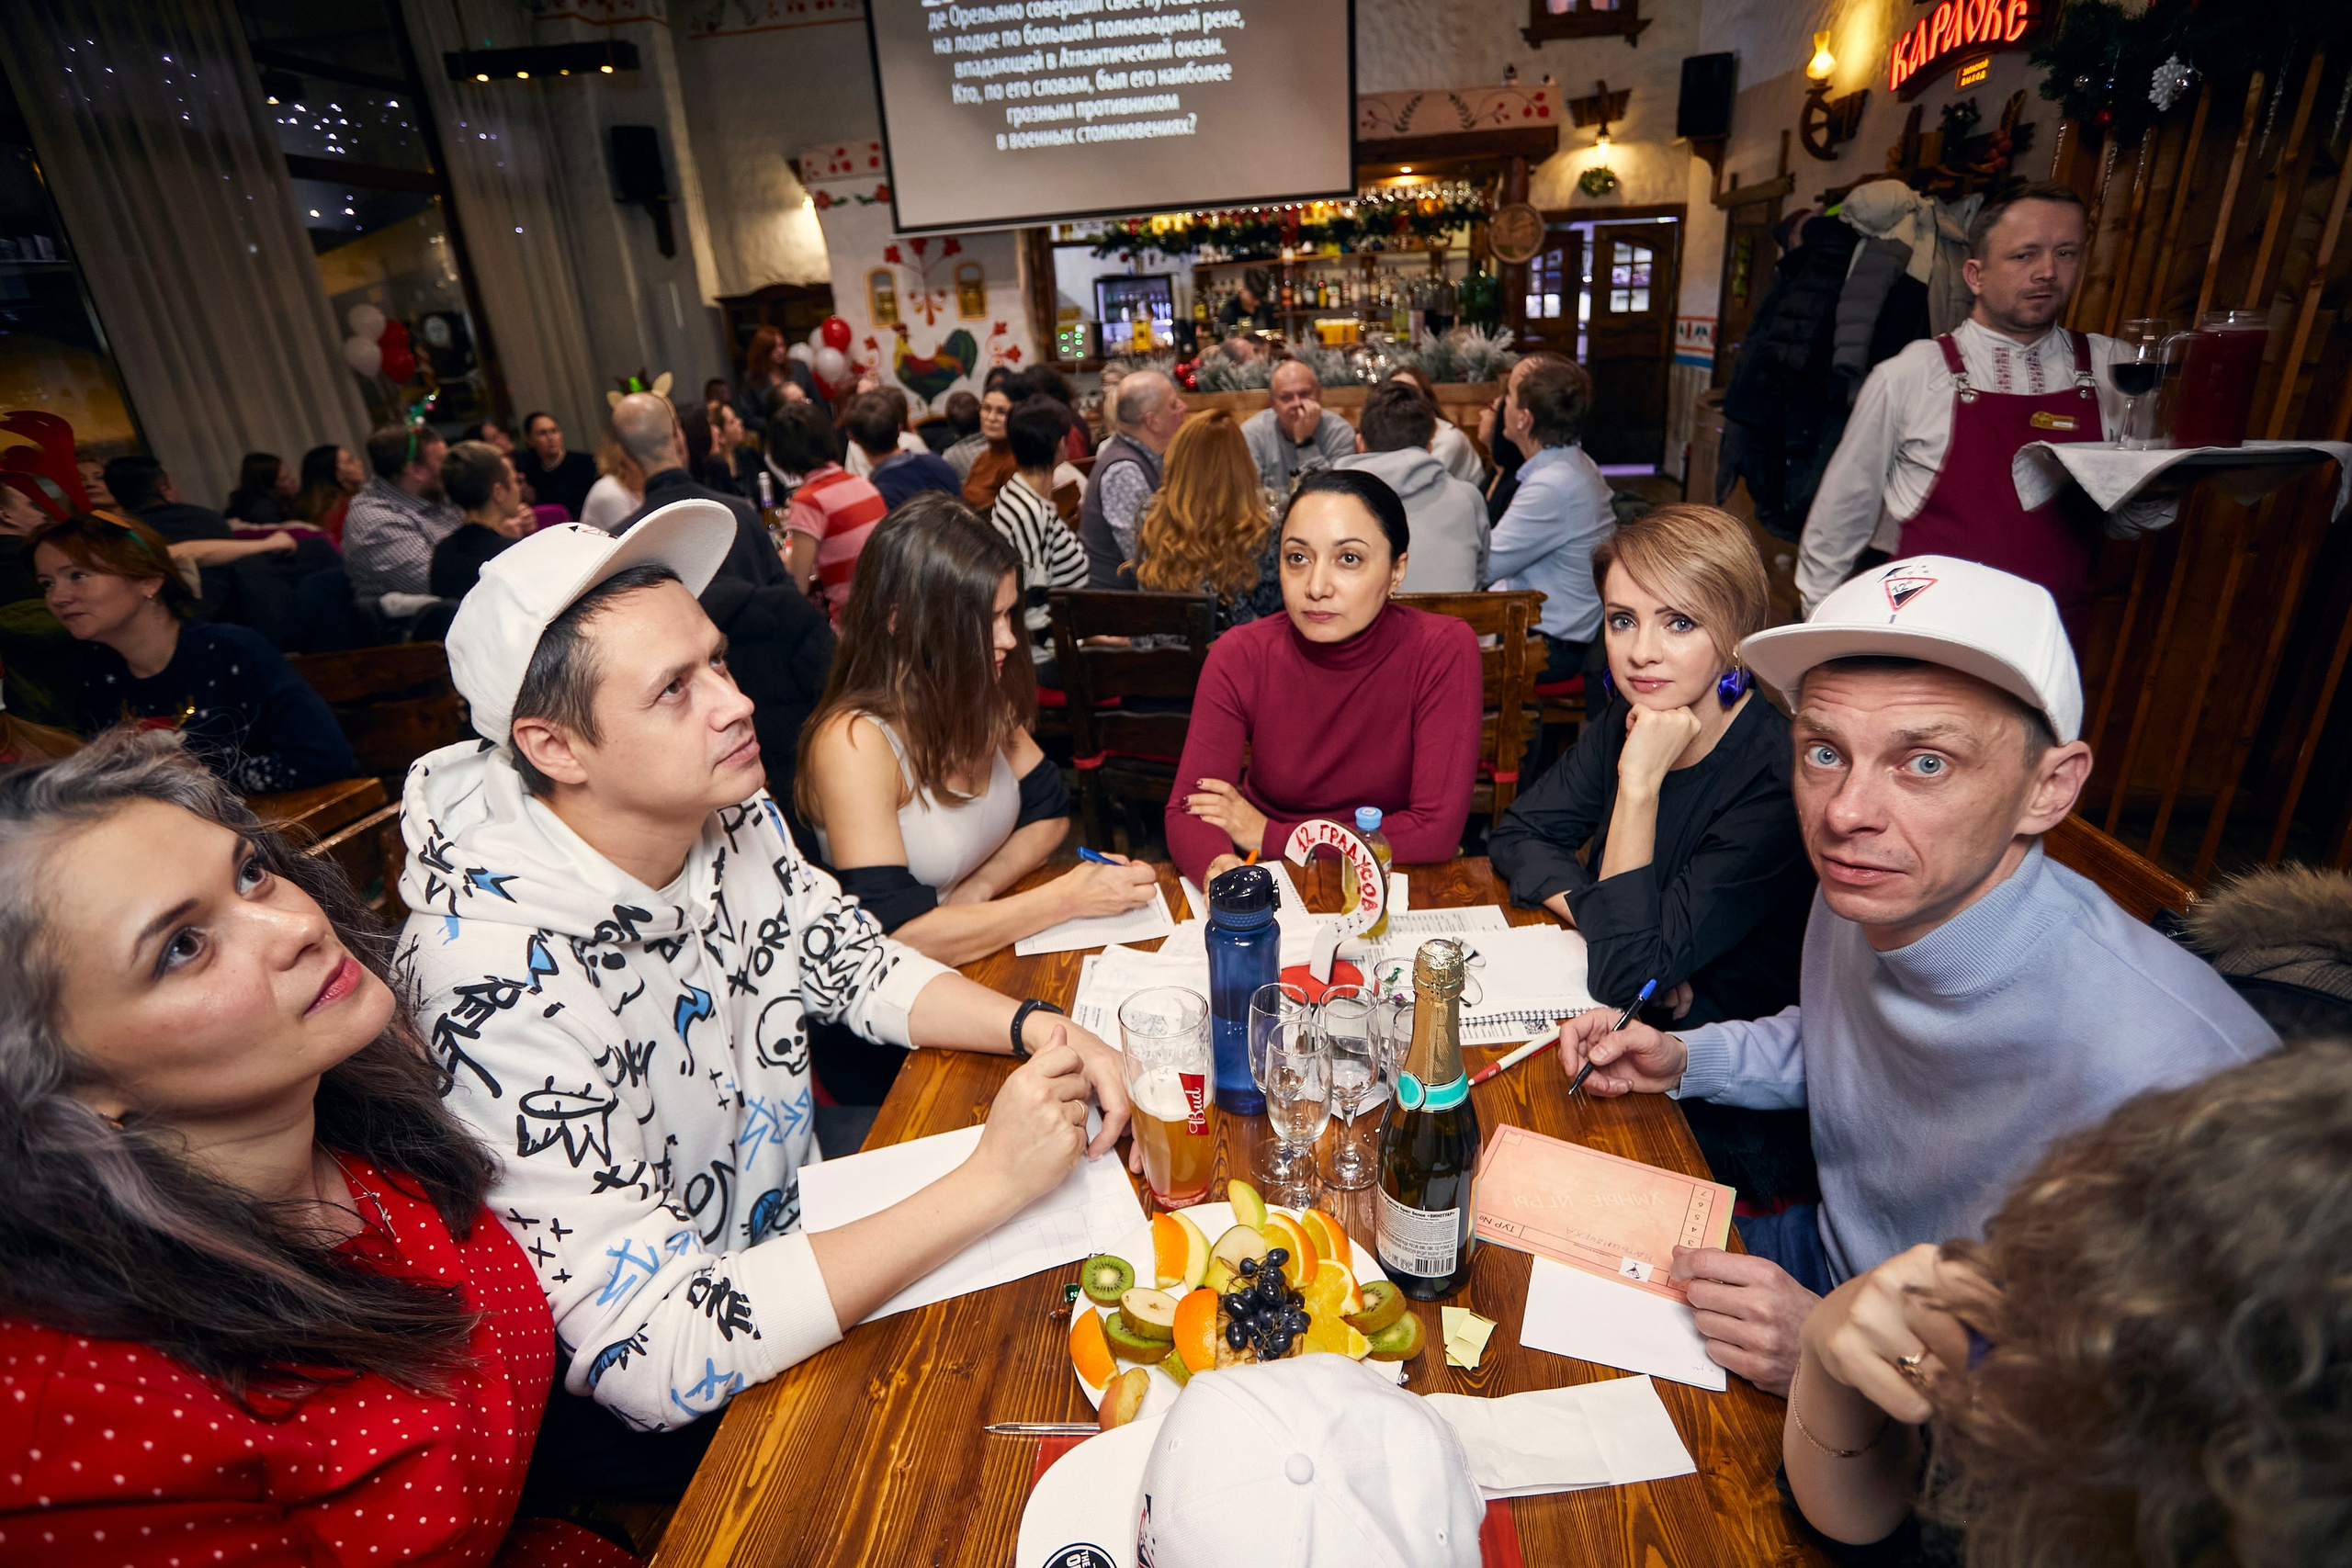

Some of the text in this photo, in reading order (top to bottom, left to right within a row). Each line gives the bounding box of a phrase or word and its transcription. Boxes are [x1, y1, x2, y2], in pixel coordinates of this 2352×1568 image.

[928, 12, 948, 31] де
[949, 4, 1024, 30] Орельяно
[933, 8, 1246, 54] на лодке по большой полноводной реке,
[955, 33, 1227, 79] впадающей в Атлантический океан.
[1889, 0, 2029, 92] КАРАОКЕ
[952, 62, 1233, 104] Кто, по его словам, был его наиболее
[1961, 70, 1986, 85] ВЫХОД
[1006, 94, 1180, 129] грозным противником
[995, 112, 1198, 151] в военных столкновениях?
[1295, 824, 1379, 912] 12 ГРАДУСОВ
[1184, 1087, 1206, 1134] Bud
[1512, 1192, 1666, 1210] УМНЫЕ ИГРЫ
[1478, 1215, 1516, 1234] ТУР №
[1080, 1550, 1091, 1568] THE
